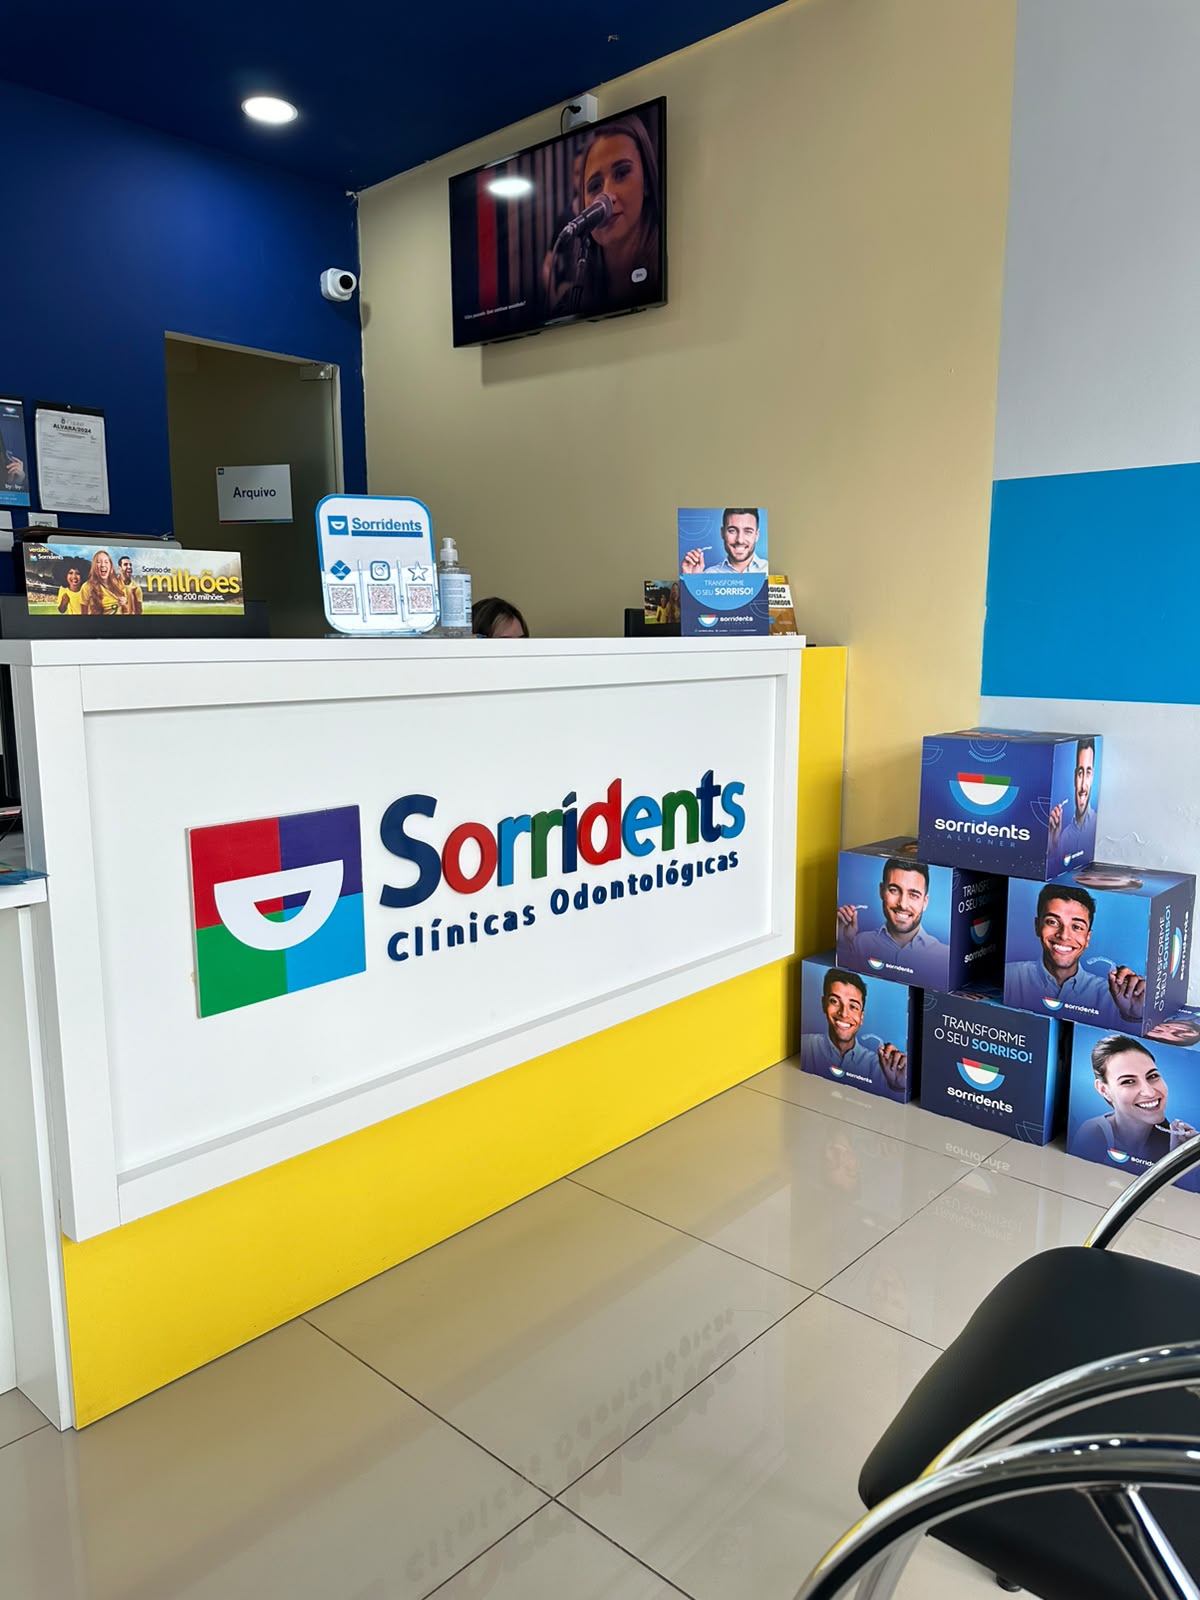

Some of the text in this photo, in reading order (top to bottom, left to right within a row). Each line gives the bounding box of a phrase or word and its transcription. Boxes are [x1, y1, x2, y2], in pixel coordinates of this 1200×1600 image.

[233, 487, 276, 499] Arquivo
[147, 569, 240, 594] milhões
[715, 587, 754, 596] SORRISO!
[934, 818, 1031, 841] sorridents
[946, 834, 1016, 848] ALIGNER
[550, 851, 739, 916] Odontológicas
[1163, 905, 1171, 971] SORRISO!
[1180, 911, 1189, 981] sorridents
[1154, 916, 1166, 1009] TRANSFORME
[1160, 973, 1168, 997] SEU
[1064, 1003, 1099, 1015] sorridents
[942, 1014, 1026, 1047] TRANSFORME
[934, 1027, 1033, 1064] O SEU SORRISO!
[845, 1071, 873, 1084] sorridents
[947, 1086, 1013, 1114] sorridents
